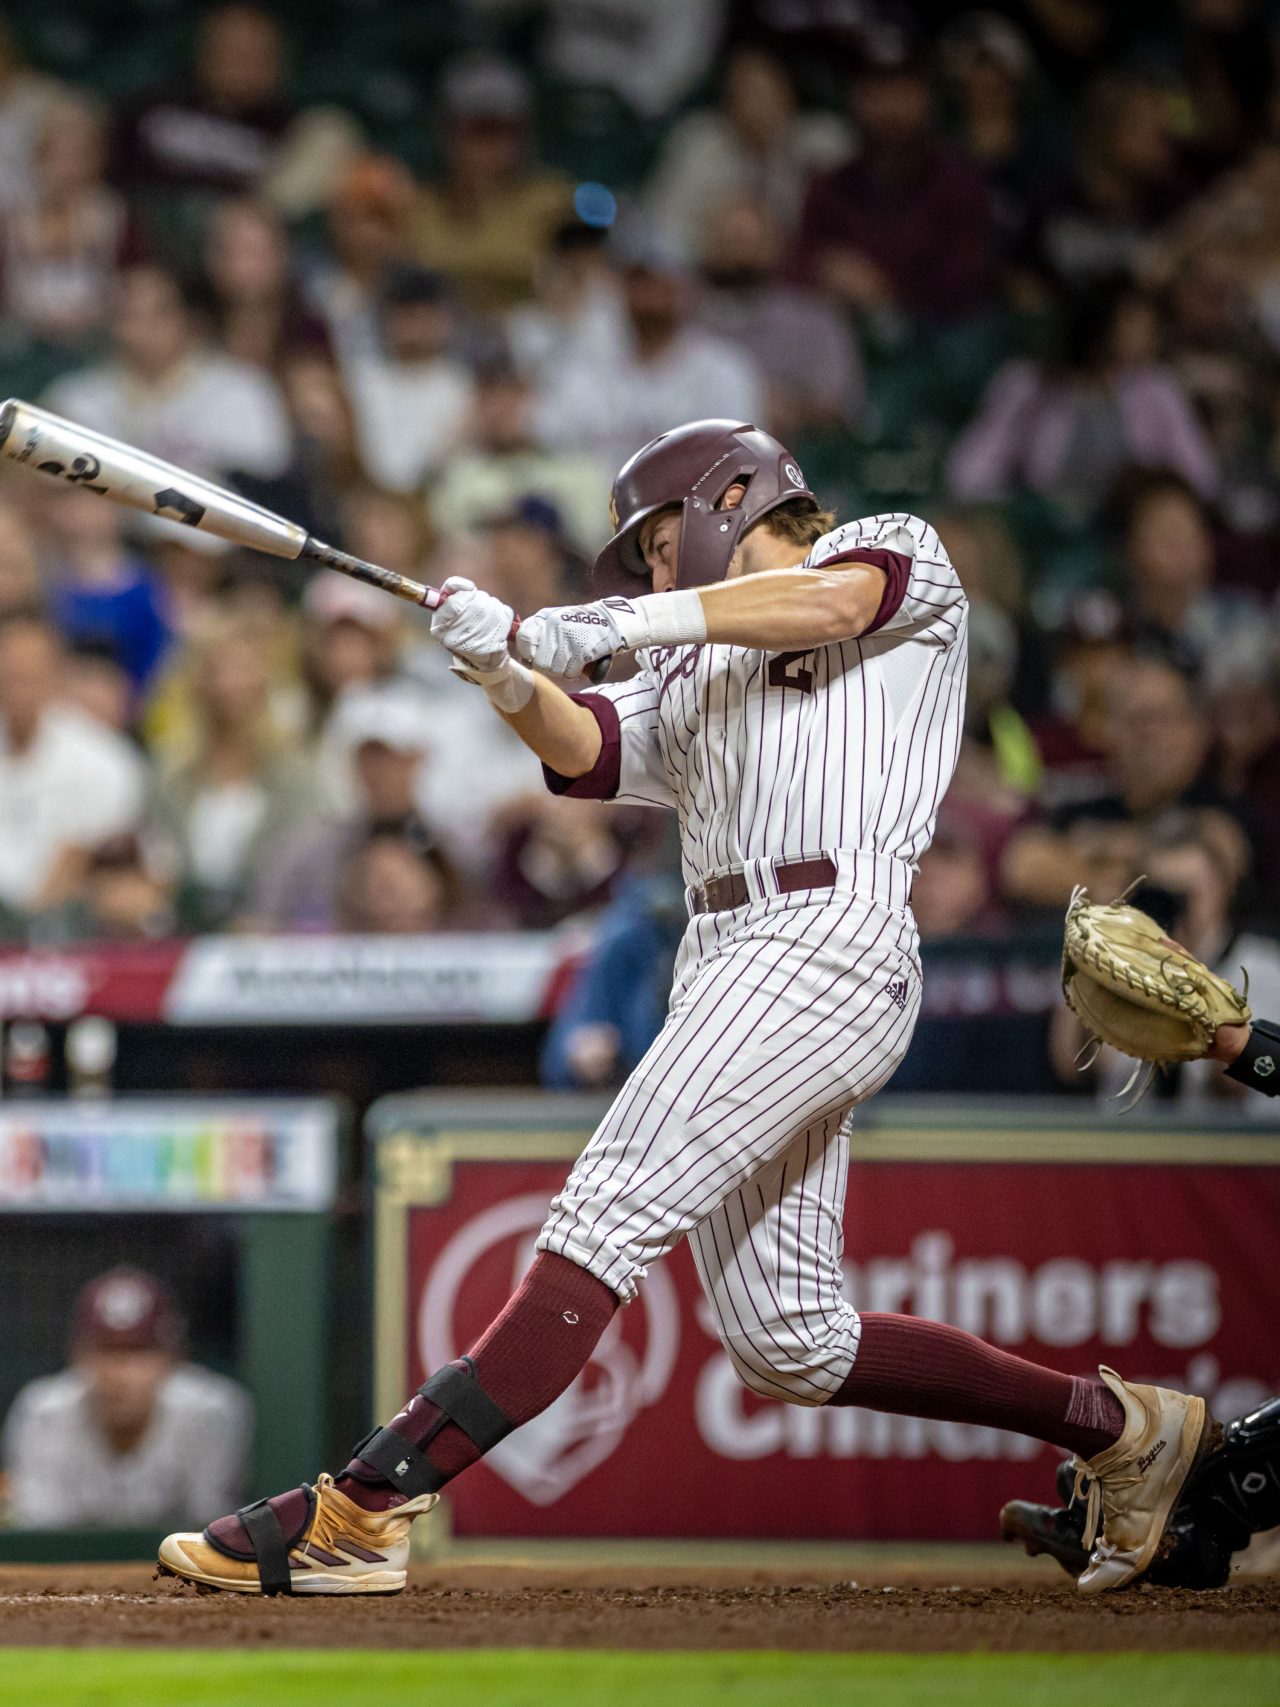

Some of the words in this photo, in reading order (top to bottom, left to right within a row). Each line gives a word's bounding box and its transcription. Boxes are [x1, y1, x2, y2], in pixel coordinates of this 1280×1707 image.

[561, 612, 608, 627] adidas
[695, 1230, 1220, 1348] riners
[1137, 1440, 1167, 1474] Aggies
